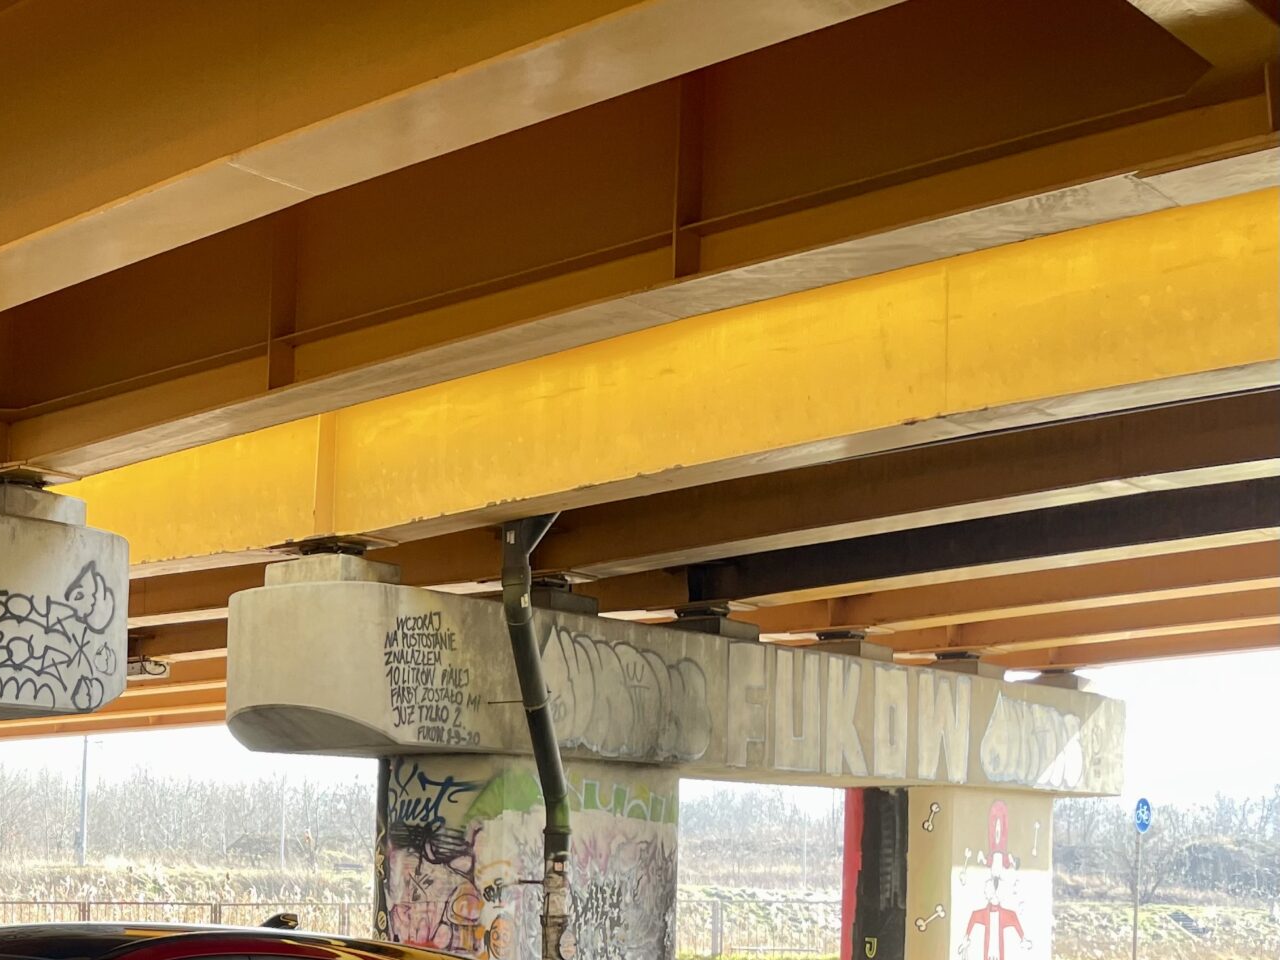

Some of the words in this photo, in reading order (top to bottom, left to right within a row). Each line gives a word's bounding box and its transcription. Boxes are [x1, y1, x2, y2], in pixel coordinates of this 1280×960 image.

[396, 611, 442, 632] WCZORAJ
[384, 630, 399, 649] NA
[418, 705, 450, 723] TYLKO
[727, 640, 972, 784] FUKOW
